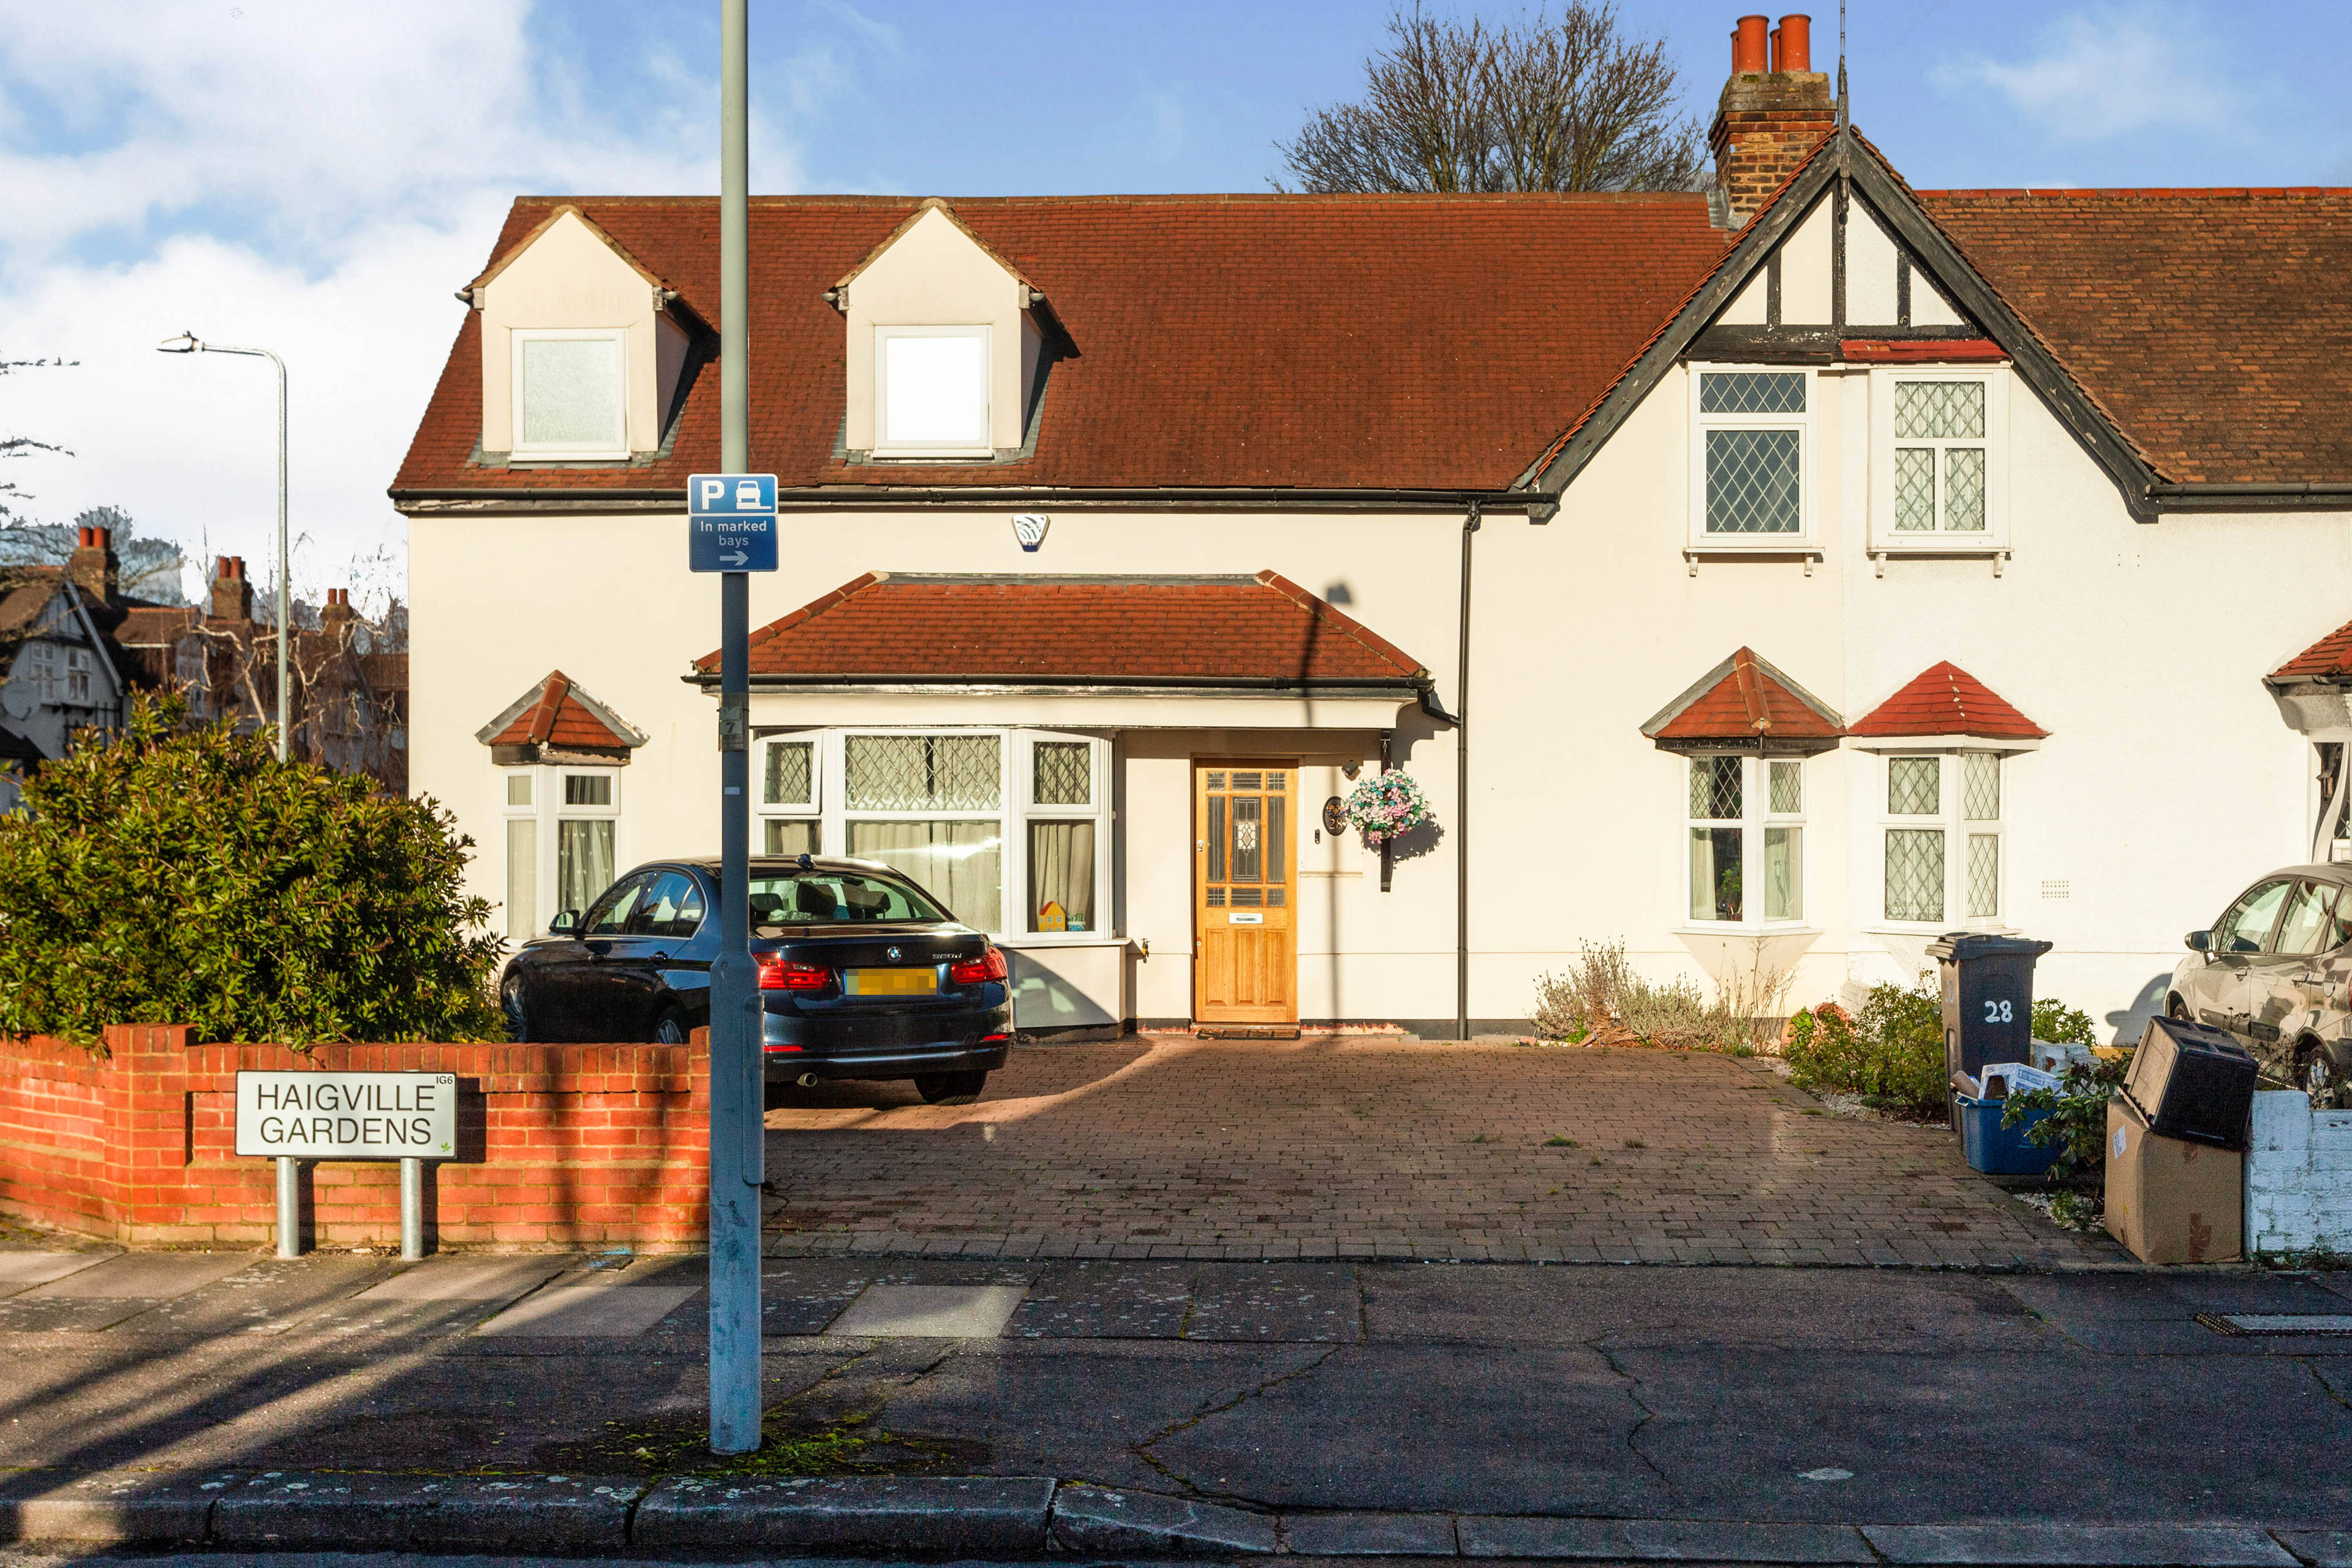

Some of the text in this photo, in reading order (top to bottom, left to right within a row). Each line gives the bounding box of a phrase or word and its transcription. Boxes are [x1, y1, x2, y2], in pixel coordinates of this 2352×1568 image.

[701, 480, 725, 510] P
[700, 520, 767, 532] In marked
[718, 535, 748, 548] bays
[1329, 818, 1343, 830] 28
[1985, 1000, 2013, 1023] 28
[436, 1075, 453, 1085] IG6
[257, 1084, 435, 1111] HAIGVILLE
[260, 1117, 431, 1145] GARDENS
